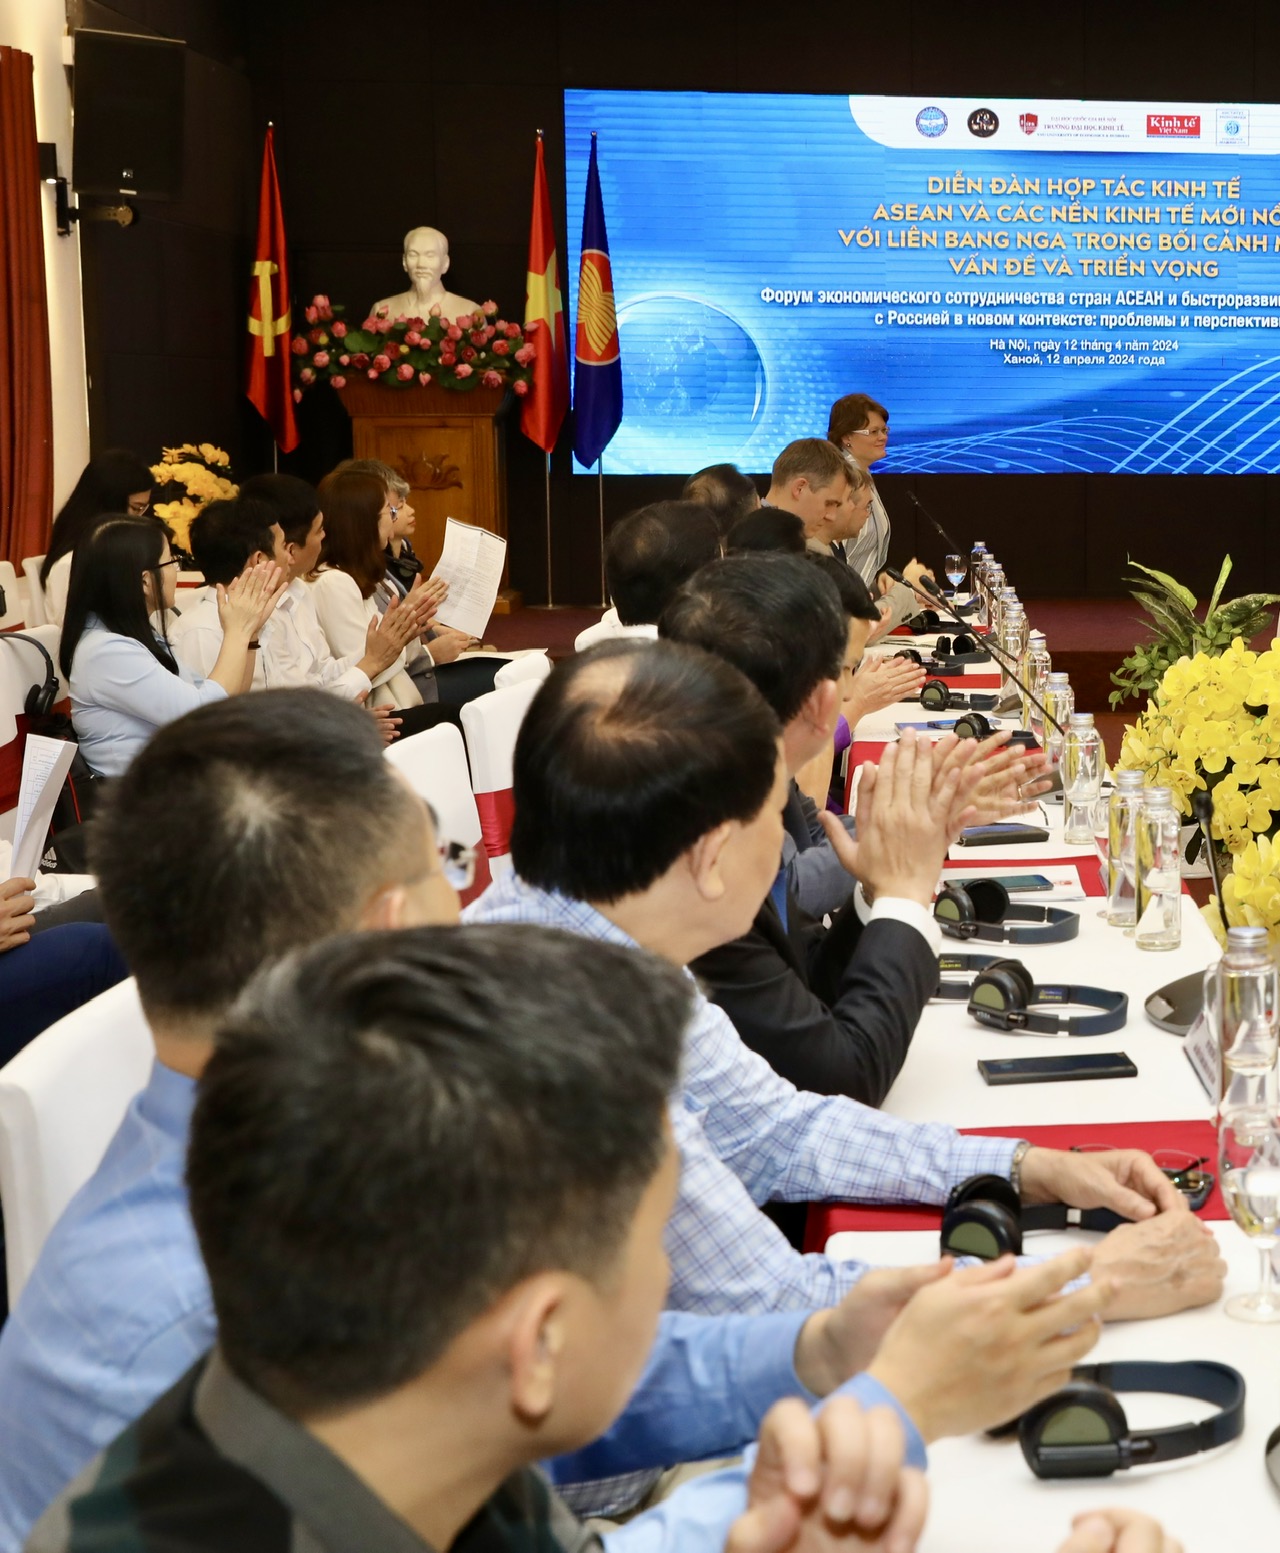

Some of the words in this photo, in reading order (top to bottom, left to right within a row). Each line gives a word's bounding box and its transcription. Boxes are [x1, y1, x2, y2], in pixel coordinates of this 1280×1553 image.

[1150, 116, 1181, 128] Kinh
[1184, 116, 1198, 128] tế
[1159, 127, 1172, 135] Việt
[928, 169, 983, 195] DIỄN
[989, 173, 1040, 195] ĐÀN
[1047, 176, 1095, 200] HỢP
[1101, 174, 1145, 197] TÁC
[1151, 180, 1206, 198] KINH
[1213, 175, 1240, 199] TẾ
[872, 203, 953, 222] ASEAN
[959, 200, 991, 222] VÀ
[996, 201, 1044, 223] CÁC
[1051, 200, 1098, 223] NỀN
[1105, 206, 1160, 224] KINH
[1166, 202, 1194, 225] TẾ
[1201, 204, 1246, 226] MỚI
[838, 225, 880, 248] VỚI
[887, 225, 938, 249] LIÊN
[945, 231, 1010, 249] BANG
[1016, 231, 1067, 250] NGA
[1072, 232, 1152, 251] TRONG
[1158, 228, 1197, 251] BỐI
[1203, 229, 1268, 253] CẢNH
[949, 252, 998, 276] VẤN
[1004, 253, 1036, 276] ĐỀ
[1041, 254, 1074, 276] VÀ
[1079, 252, 1146, 277] TRIỂN
[1151, 260, 1219, 282] VỌNG
[760, 287, 813, 305] Форум
[818, 291, 941, 305] экономического
[946, 291, 1065, 307] сотрудничества
[1069, 292, 1113, 308] стран
[1115, 290, 1164, 306] АСЕАН
[1168, 293, 1177, 306] и
[874, 313, 884, 325] с
[888, 310, 950, 325] Россией
[954, 314, 963, 325] в
[967, 314, 1014, 326] новом
[1018, 314, 1097, 327] контексте:
[1099, 311, 1176, 329] проблемы
[1180, 315, 1190, 327] и
[990, 338, 1005, 350] Hà
[1008, 338, 1031, 352] Nội,
[1033, 339, 1061, 353] ngày
[1063, 340, 1078, 350] 12
[1080, 339, 1112, 353] tháng
[1115, 340, 1122, 350] 4
[1124, 339, 1149, 351] năm
[1152, 340, 1179, 351] 2024
[1003, 353, 1044, 366] Ханой,
[1046, 354, 1060, 365] 12
[1063, 356, 1105, 367] апреля
[1108, 354, 1135, 365] 2024
[1138, 355, 1165, 367] года
